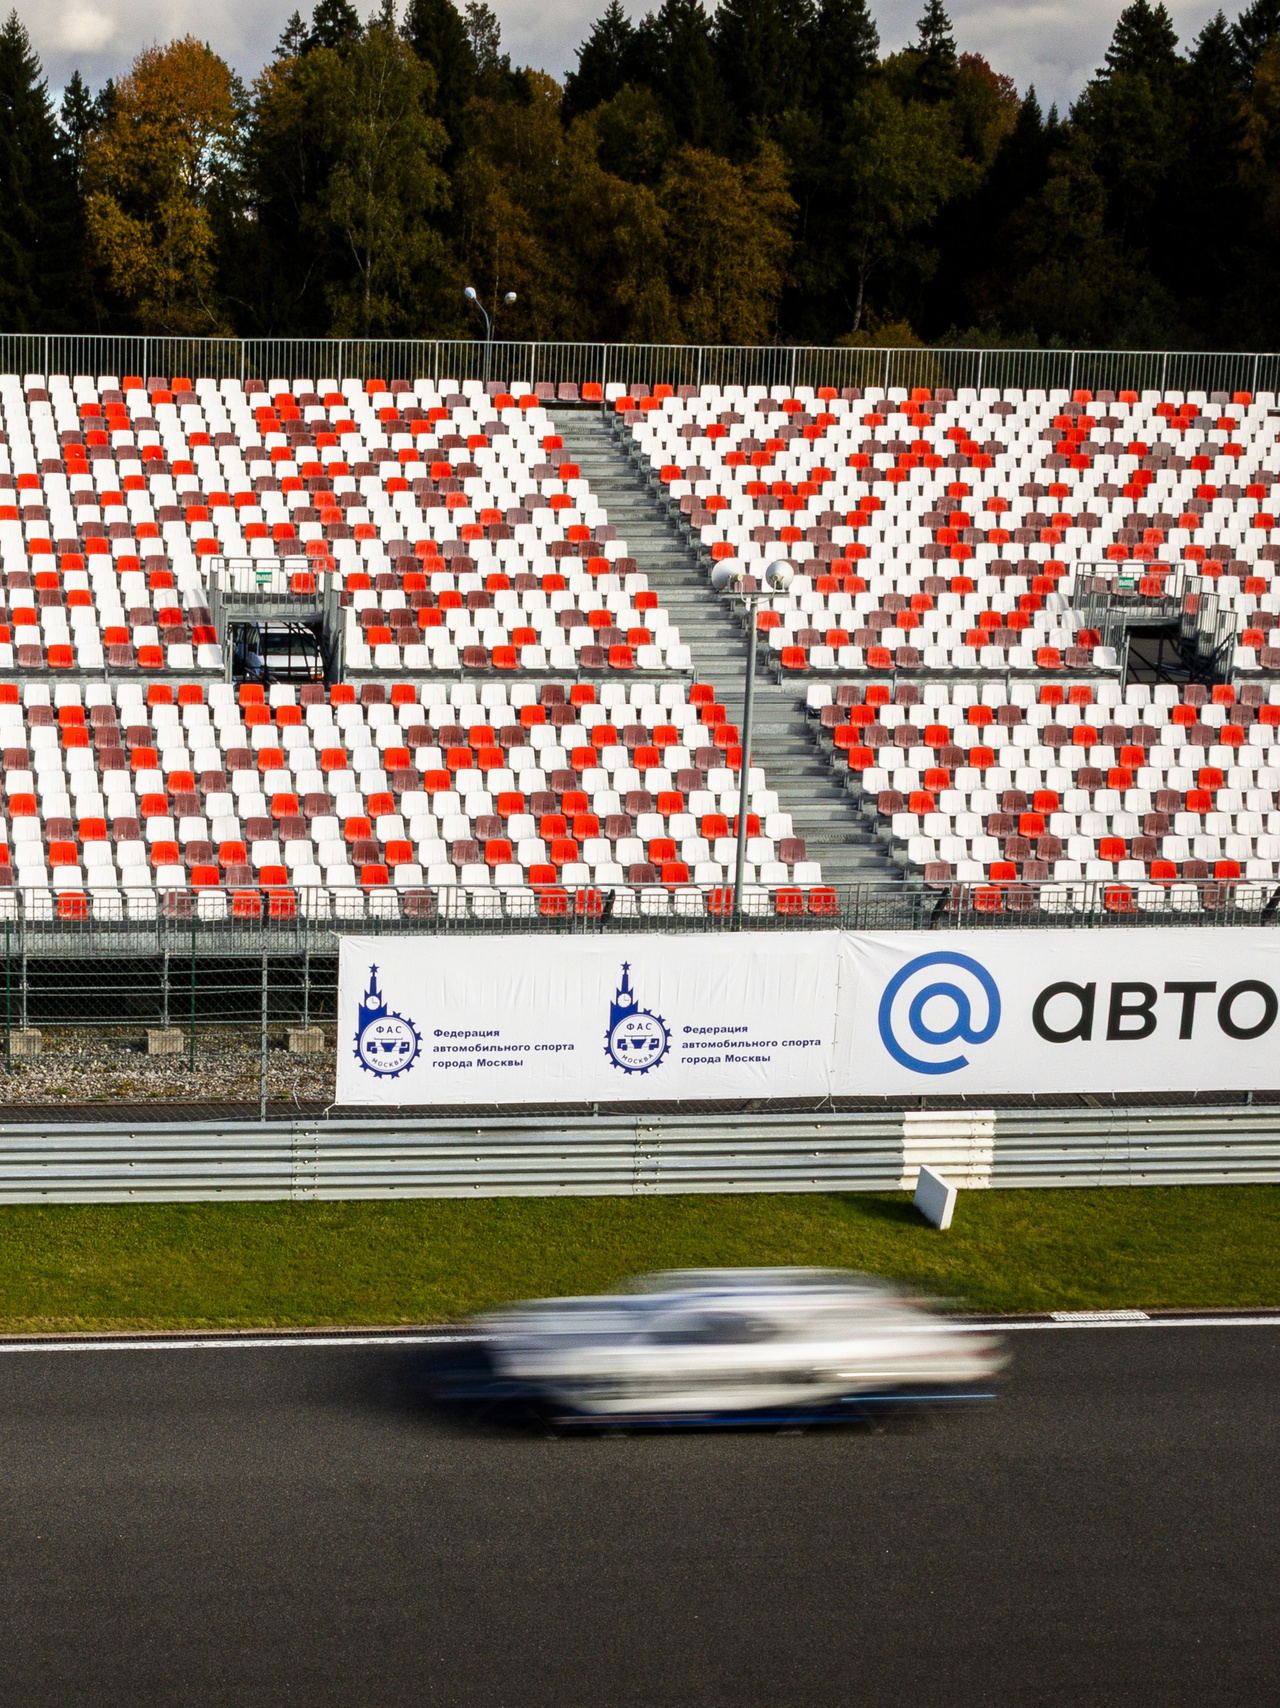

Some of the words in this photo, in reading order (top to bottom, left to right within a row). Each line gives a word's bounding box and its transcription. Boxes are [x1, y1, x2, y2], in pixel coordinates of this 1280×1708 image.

[375, 1025, 402, 1034] ФАС
[626, 1022, 653, 1031] ФАС
[682, 1025, 748, 1035] Федерация
[433, 1028, 500, 1038] Федерация
[432, 1044, 531, 1053] автомобильного
[534, 1043, 575, 1053] спорта
[681, 1040, 778, 1049] автомобильного
[781, 1039, 821, 1048] спорта
[371, 1057, 404, 1068] МОСКВА
[432, 1060, 473, 1069] города
[476, 1058, 524, 1067] Москвы
[621, 1053, 654, 1065] МОСКВА
[681, 1056, 721, 1065] города
[724, 1054, 771, 1063] Москвы
